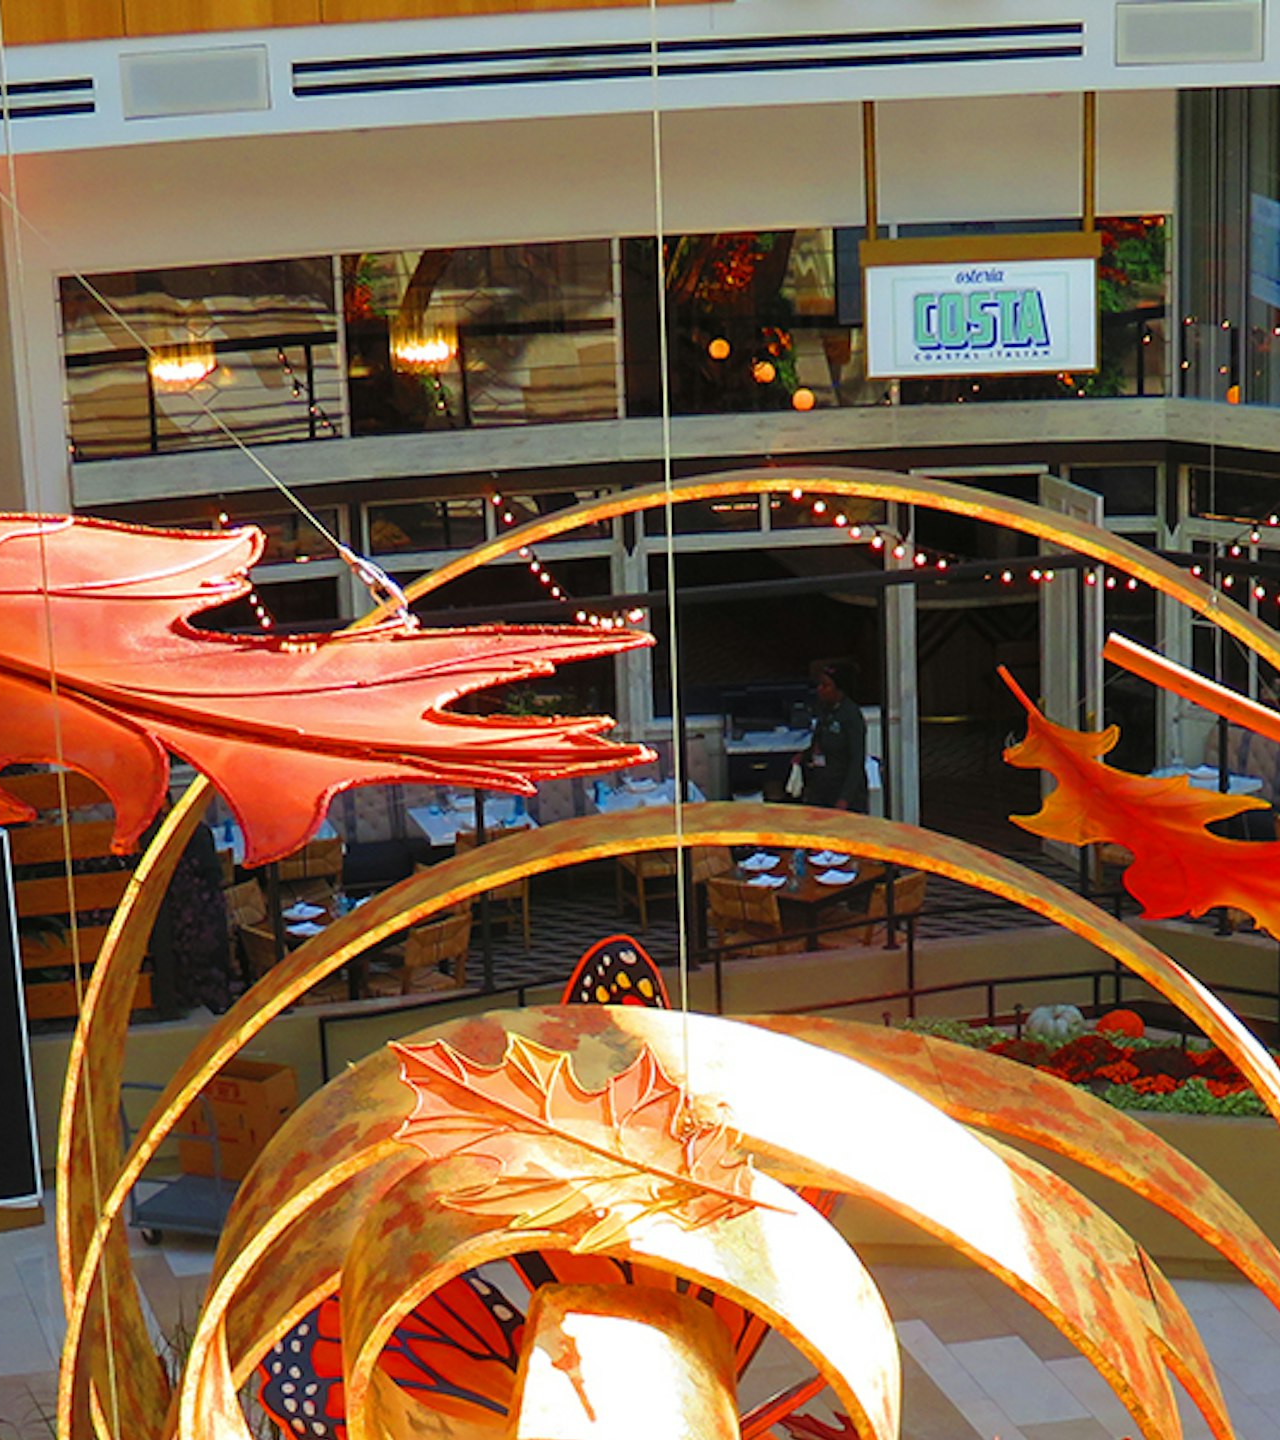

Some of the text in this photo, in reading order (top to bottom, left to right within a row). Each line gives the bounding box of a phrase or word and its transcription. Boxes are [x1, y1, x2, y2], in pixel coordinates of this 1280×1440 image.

[956, 268, 1004, 284] osteria
[914, 289, 1051, 351] COSTA
[913, 351, 1051, 362] COASTAL ITALIAN
